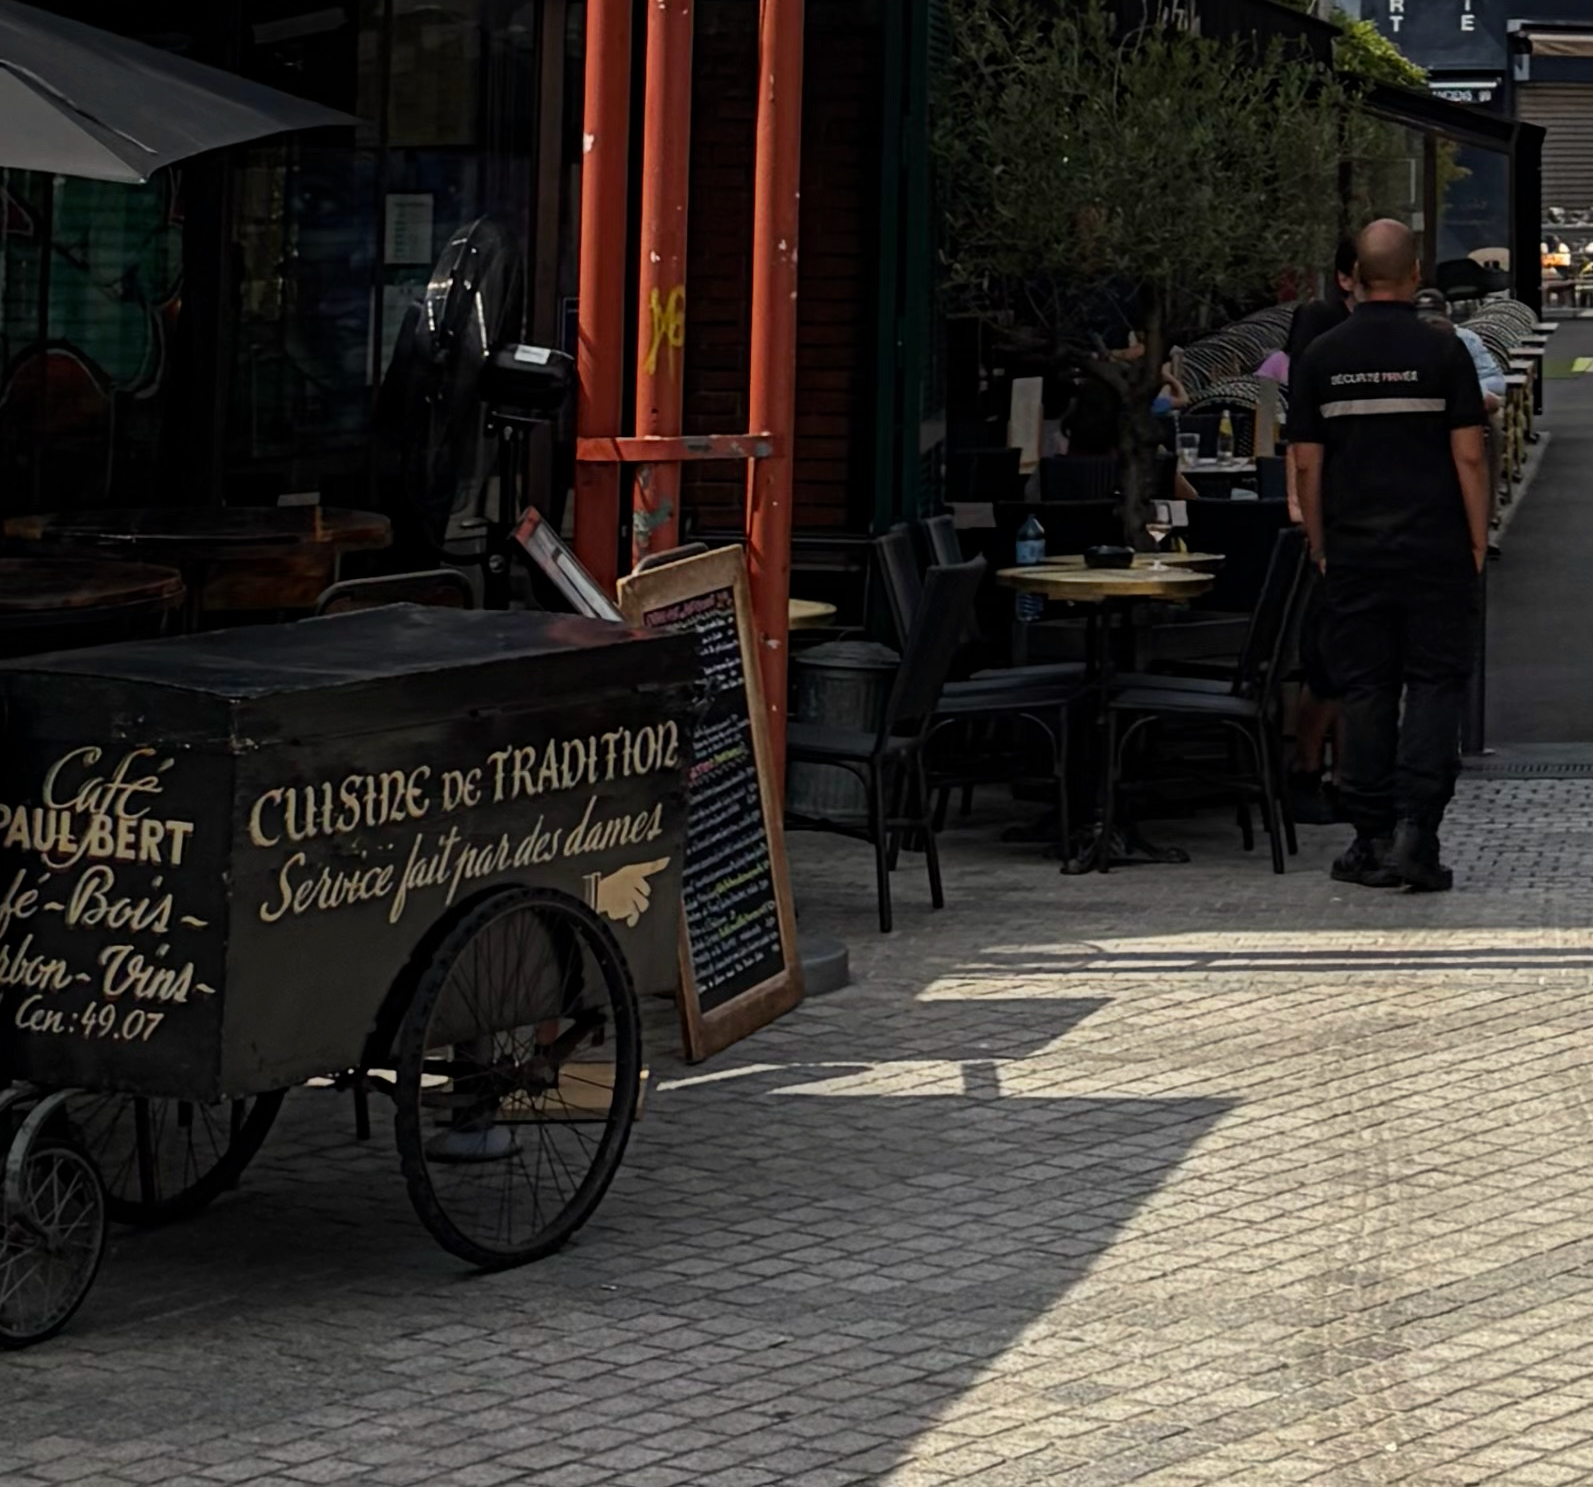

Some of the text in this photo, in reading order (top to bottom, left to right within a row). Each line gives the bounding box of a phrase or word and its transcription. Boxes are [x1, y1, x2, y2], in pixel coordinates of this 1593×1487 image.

[43, 745, 175, 869] Café
[487, 719, 679, 802] TRADITION
[87, 812, 195, 866] BERT
[259, 795, 664, 924] Service fait par des dames
